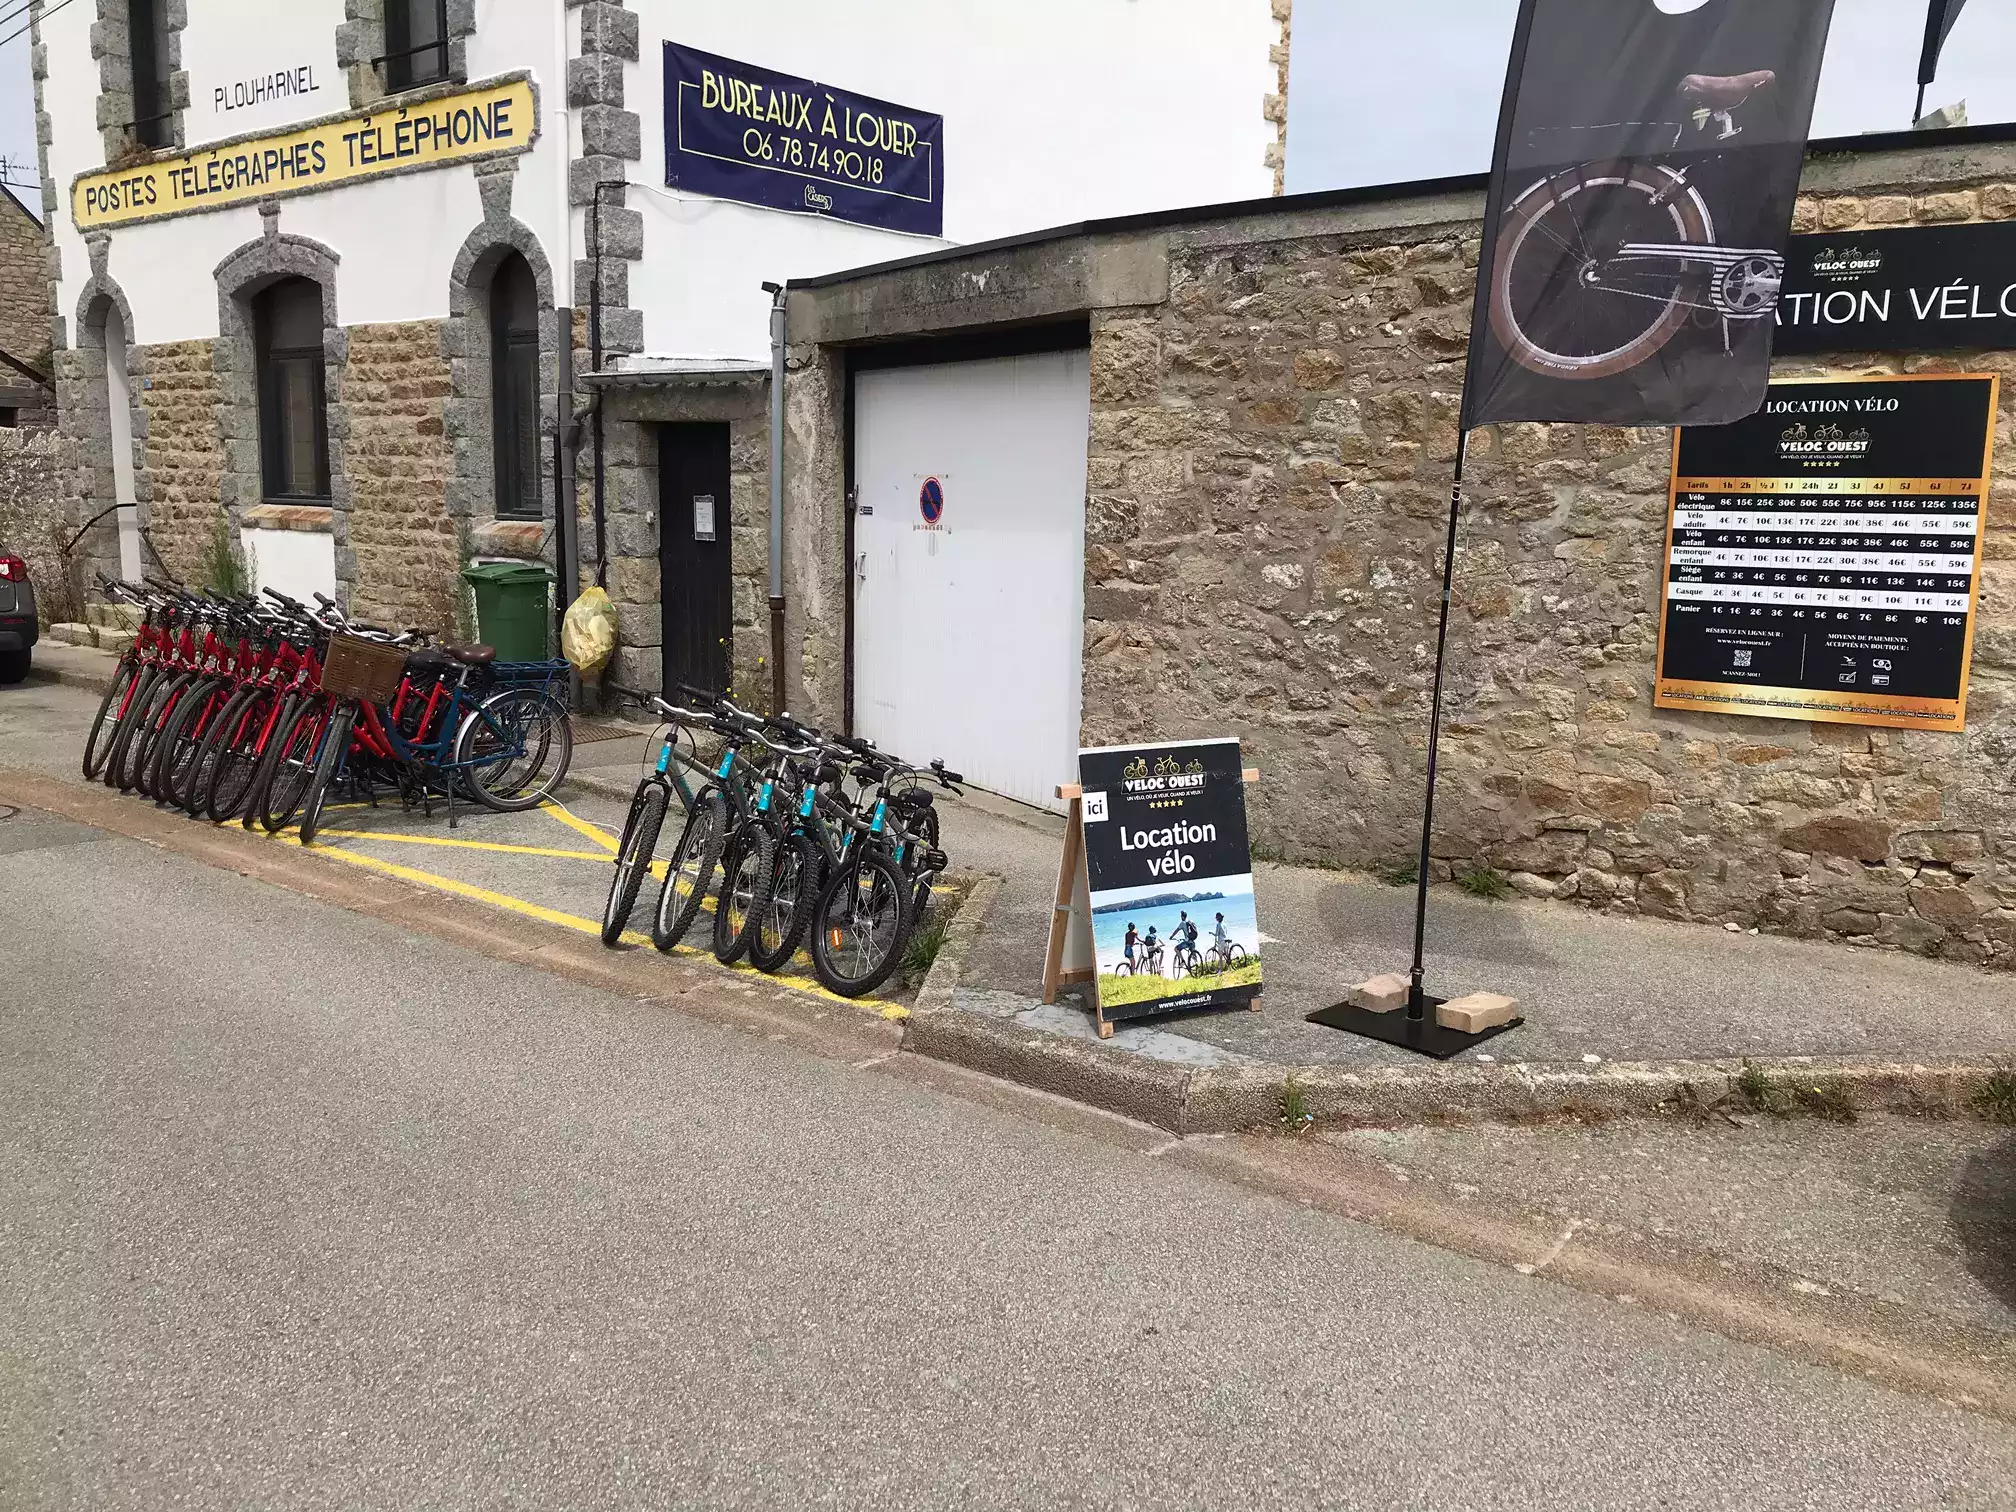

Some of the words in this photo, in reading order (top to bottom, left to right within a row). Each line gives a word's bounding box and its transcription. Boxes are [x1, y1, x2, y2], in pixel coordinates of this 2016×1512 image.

[214, 66, 319, 112] PLOUHARNEL
[702, 70, 813, 133] BUREAUX
[821, 94, 838, 138] À
[846, 108, 917, 157] LOUER
[86, 175, 156, 215] POSTES
[168, 141, 326, 198] TÉLÉGRAPHES
[342, 98, 513, 167] TÉLÉPHONE
[1766, 400, 1850, 413] LOCATION
[1854, 396, 1899, 411] VÉLO
[1674, 548, 1712, 556] Remorque
[1681, 566, 1701, 574] Siège
[1818, 575, 1830, 583] 7€
[1717, 638, 1771, 646] www.velocouest.fr
[1825, 640, 1858, 648] ACCEPTÉS
[1088, 800, 1103, 815] ici
[1120, 820, 1216, 850] Location
[1147, 849, 1195, 876] vélo
[1159, 995, 1212, 1009] www.velocouest.fr
